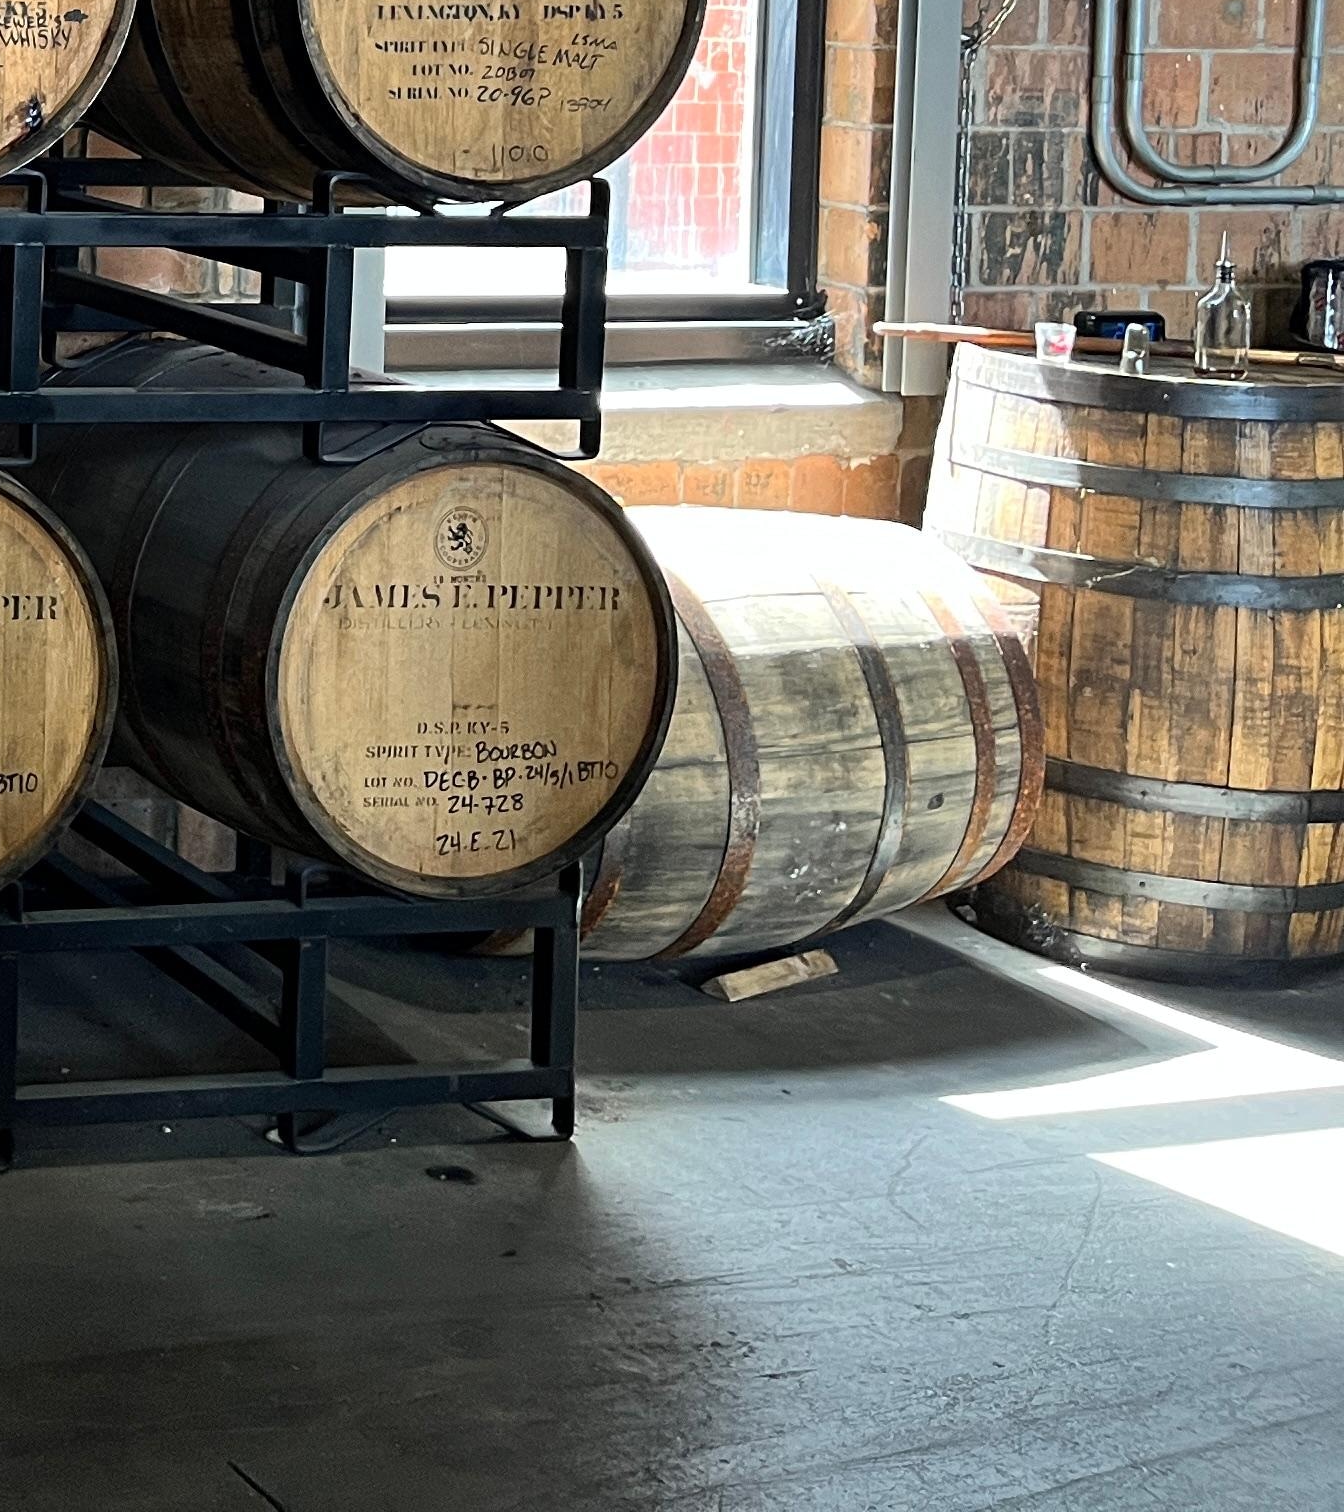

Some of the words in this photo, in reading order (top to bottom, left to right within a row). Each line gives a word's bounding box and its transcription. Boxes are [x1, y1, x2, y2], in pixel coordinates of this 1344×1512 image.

[374, 39, 427, 54] SPIRIT
[477, 37, 549, 64] SINGLE
[552, 50, 606, 72] MALT
[412, 64, 442, 76] LOT
[323, 584, 440, 610] JAMES
[487, 584, 620, 611] PEPPER
[365, 745, 418, 759] SPIRIT
[475, 740, 557, 763] BOURBON
